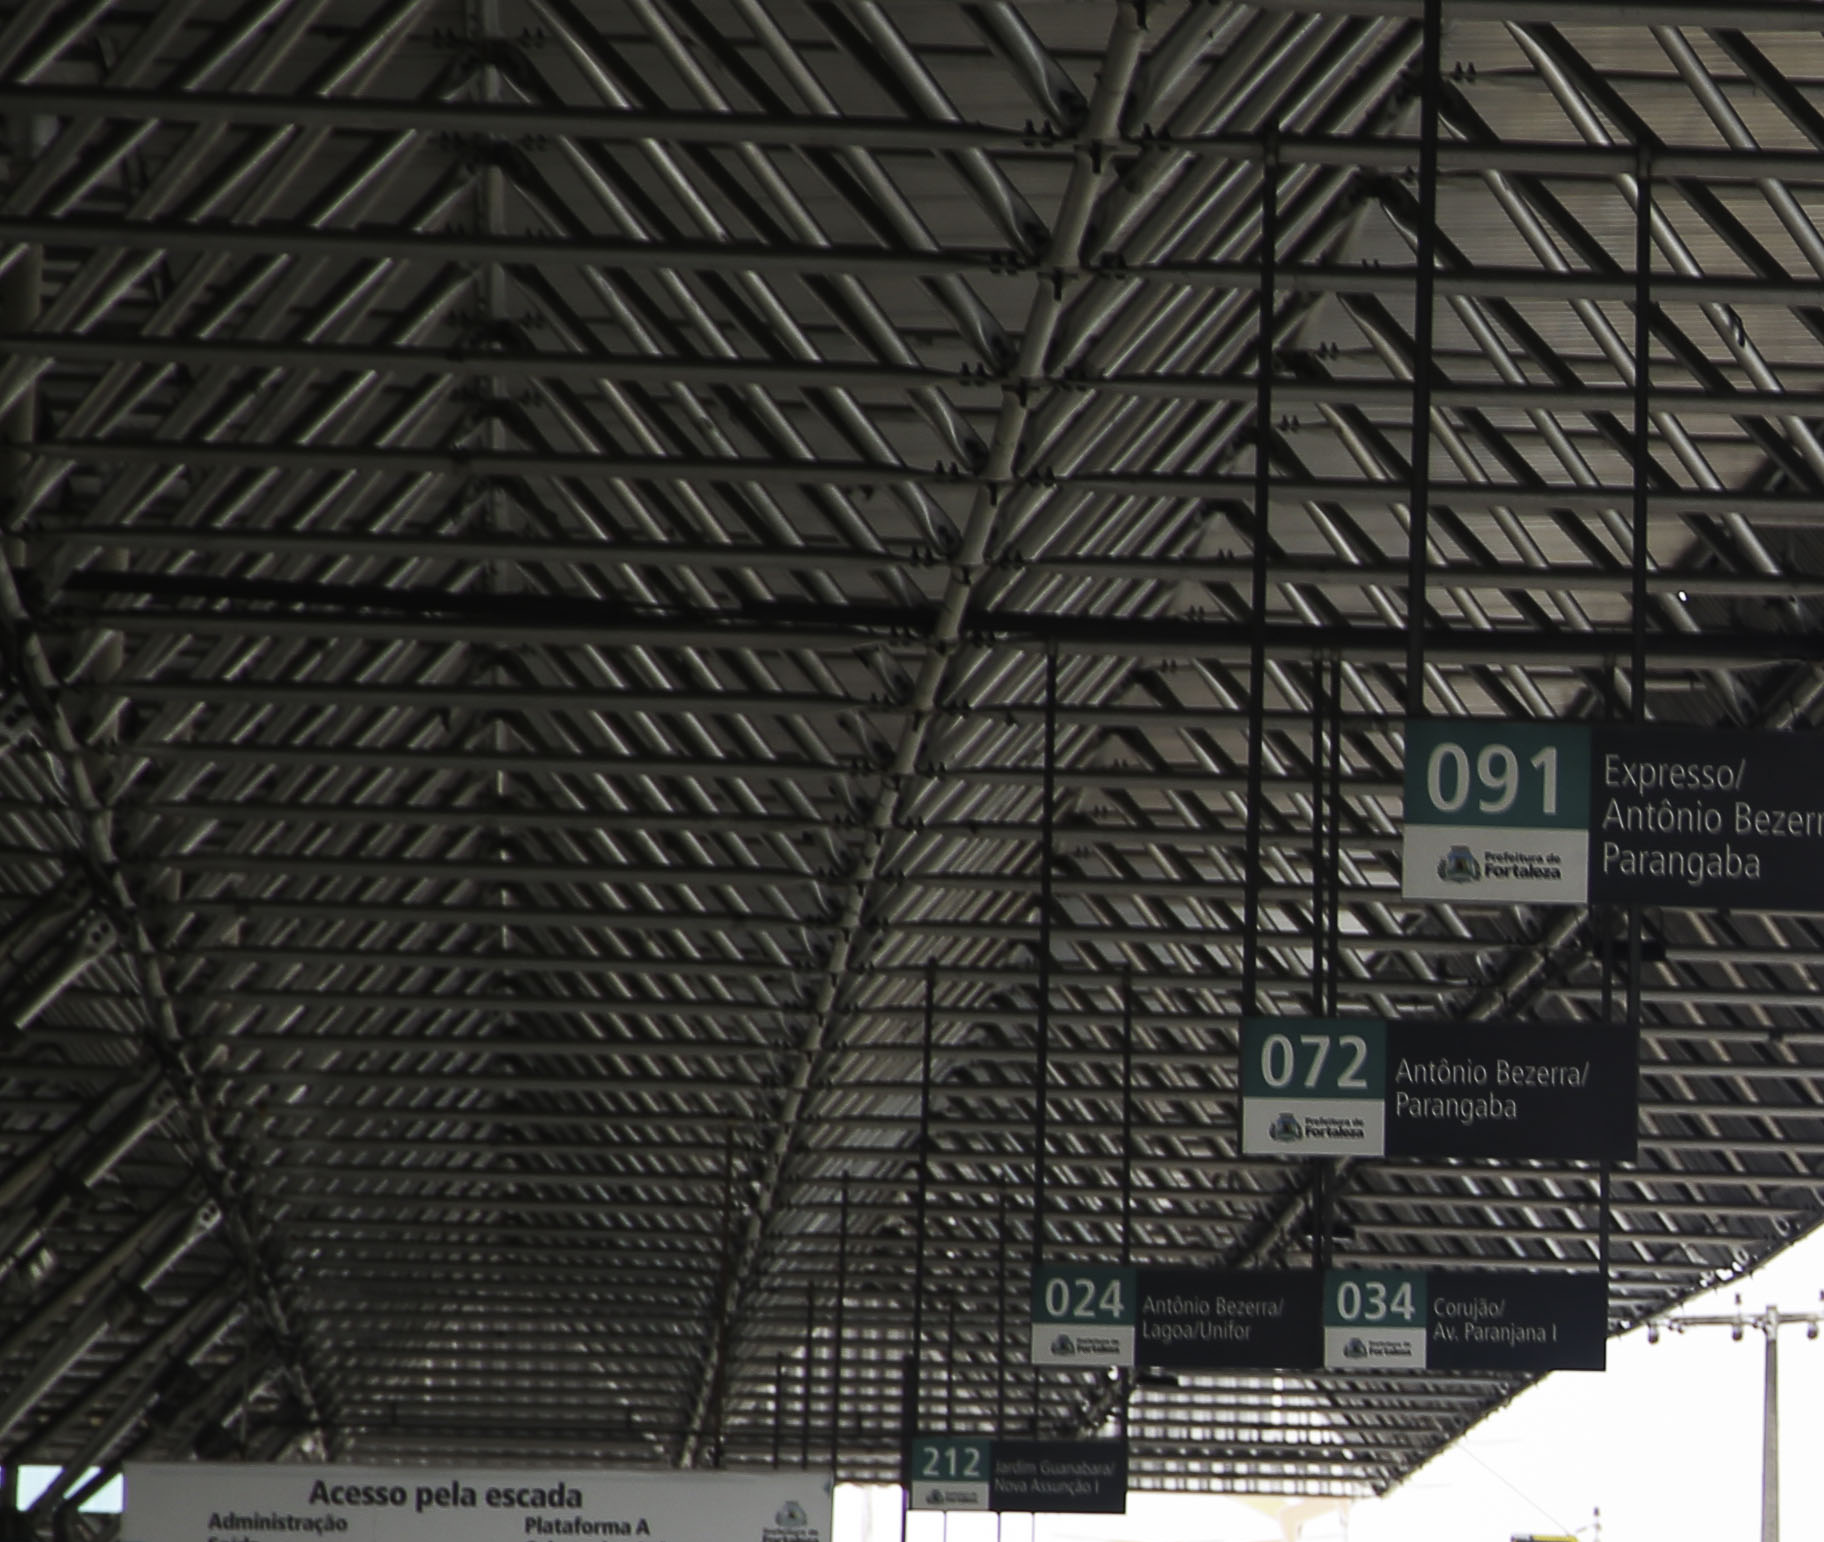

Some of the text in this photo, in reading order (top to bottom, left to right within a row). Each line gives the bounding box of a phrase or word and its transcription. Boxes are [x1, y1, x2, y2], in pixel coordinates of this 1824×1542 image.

[1427, 742, 1558, 815] 091
[1604, 753, 1747, 796] Expresso/
[1602, 798, 1723, 834] Antônio
[1484, 862, 1562, 881] Fortaleza
[1602, 841, 1762, 885] Parangaba
[1260, 1033, 1368, 1091] 072
[1396, 1058, 1590, 1087] Antônio Bezerra/
[1396, 1091, 1518, 1126] Parangaba
[1045, 1277, 1125, 1318] 024
[1142, 1296, 1210, 1317] Antônio
[1337, 1281, 1415, 1321] 034
[1432, 1322, 1458, 1342] Av.
[1464, 1323, 1546, 1347] Paranjana
[922, 1446, 980, 1476] 212
[308, 1480, 583, 1513] Acesso pela escada
[207, 1512, 349, 1537] Administração
[524, 1516, 650, 1536] Plataforma A
